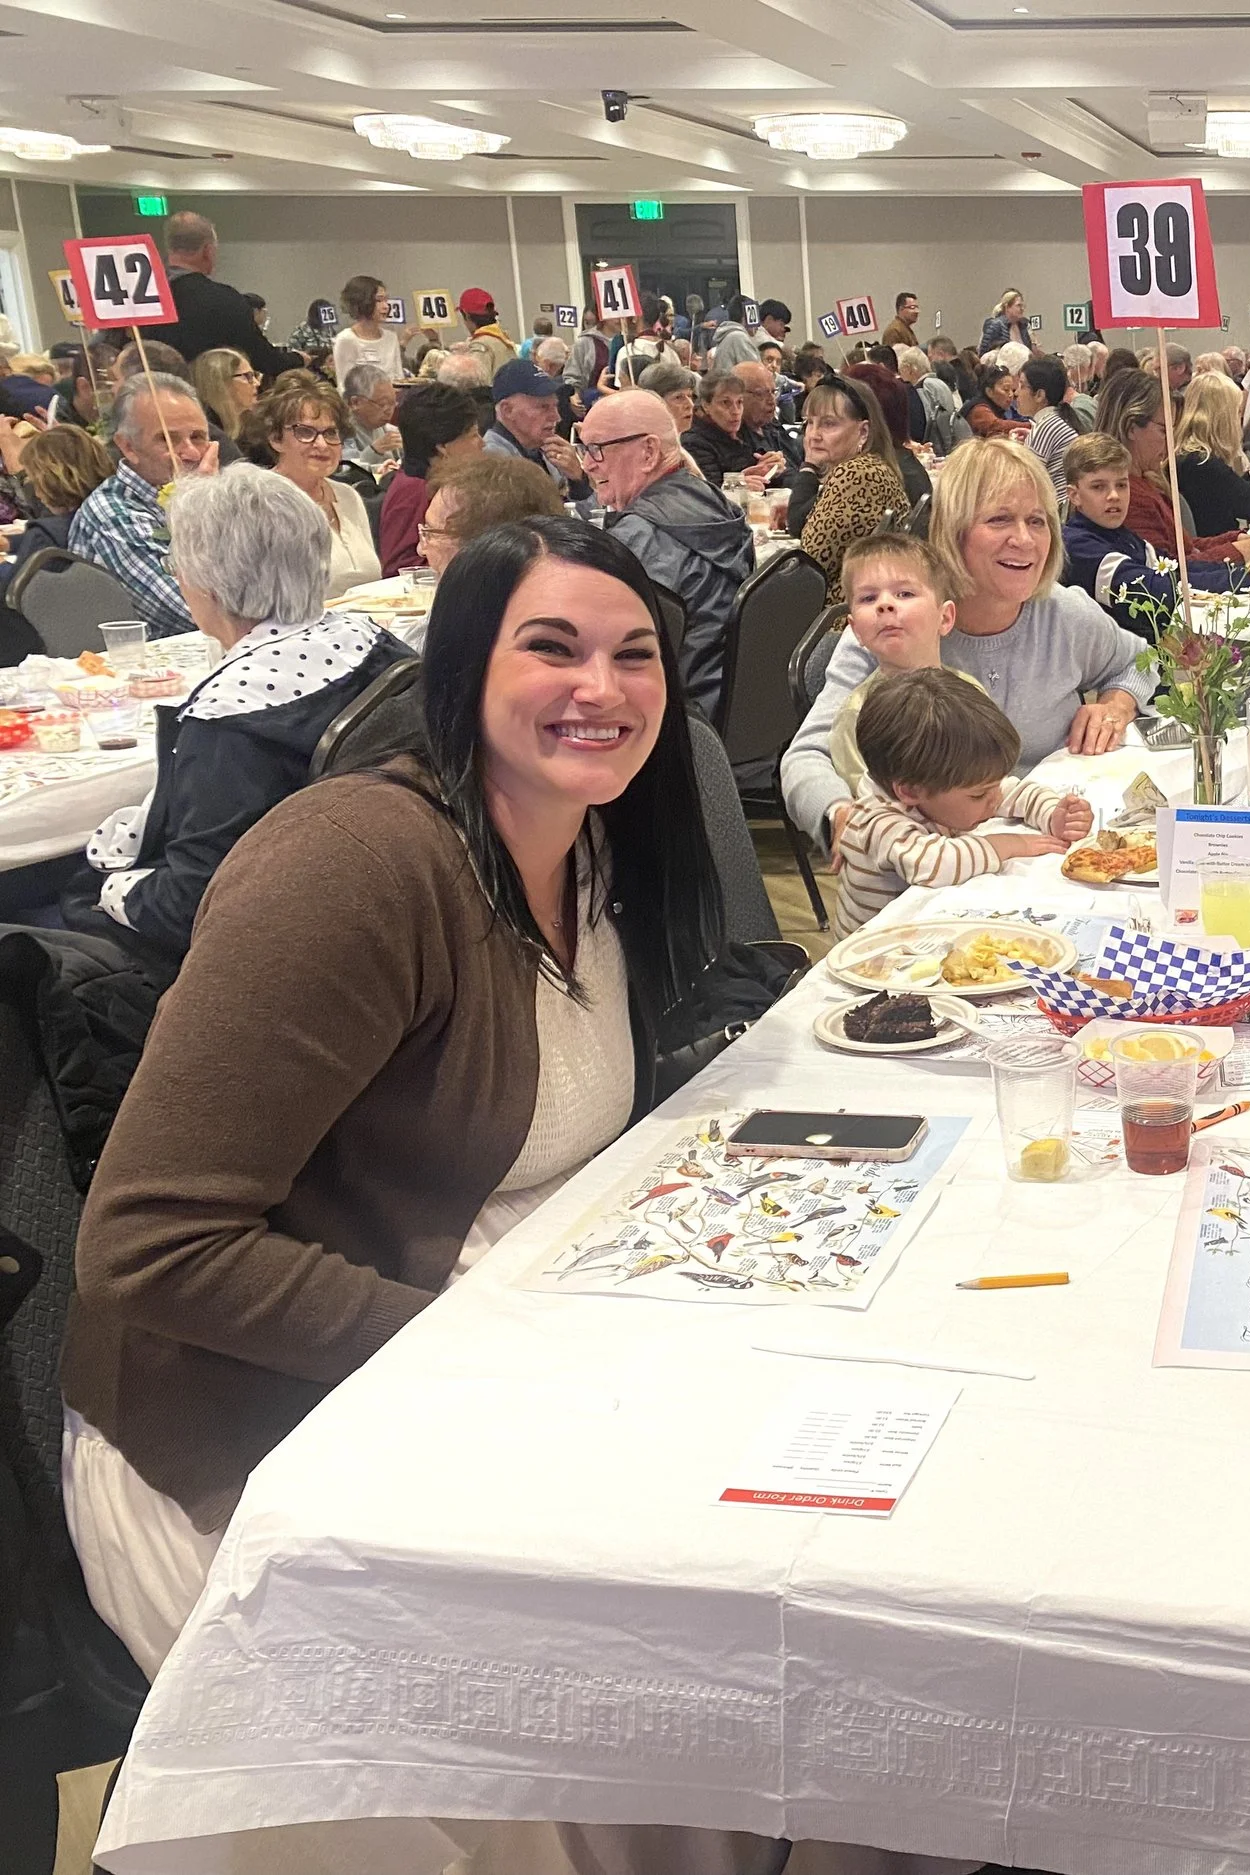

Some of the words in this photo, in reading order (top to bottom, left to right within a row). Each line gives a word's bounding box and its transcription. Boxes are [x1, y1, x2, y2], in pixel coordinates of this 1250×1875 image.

[1116, 201, 1193, 298] 39
[94, 252, 161, 306] 42
[60, 279, 80, 309] 4
[603, 277, 630, 312] 41
[422, 296, 448, 319] 46
[845, 303, 871, 329] 40
[560, 310, 576, 324] 22
[824, 317, 837, 333] 19
[1069, 308, 1083, 325] 12
[1185, 812, 1218, 822] Tonight's
[752, 1491, 788, 1503] Form
[788, 1494, 827, 1505] Order
[830, 1497, 865, 1507] Drink
